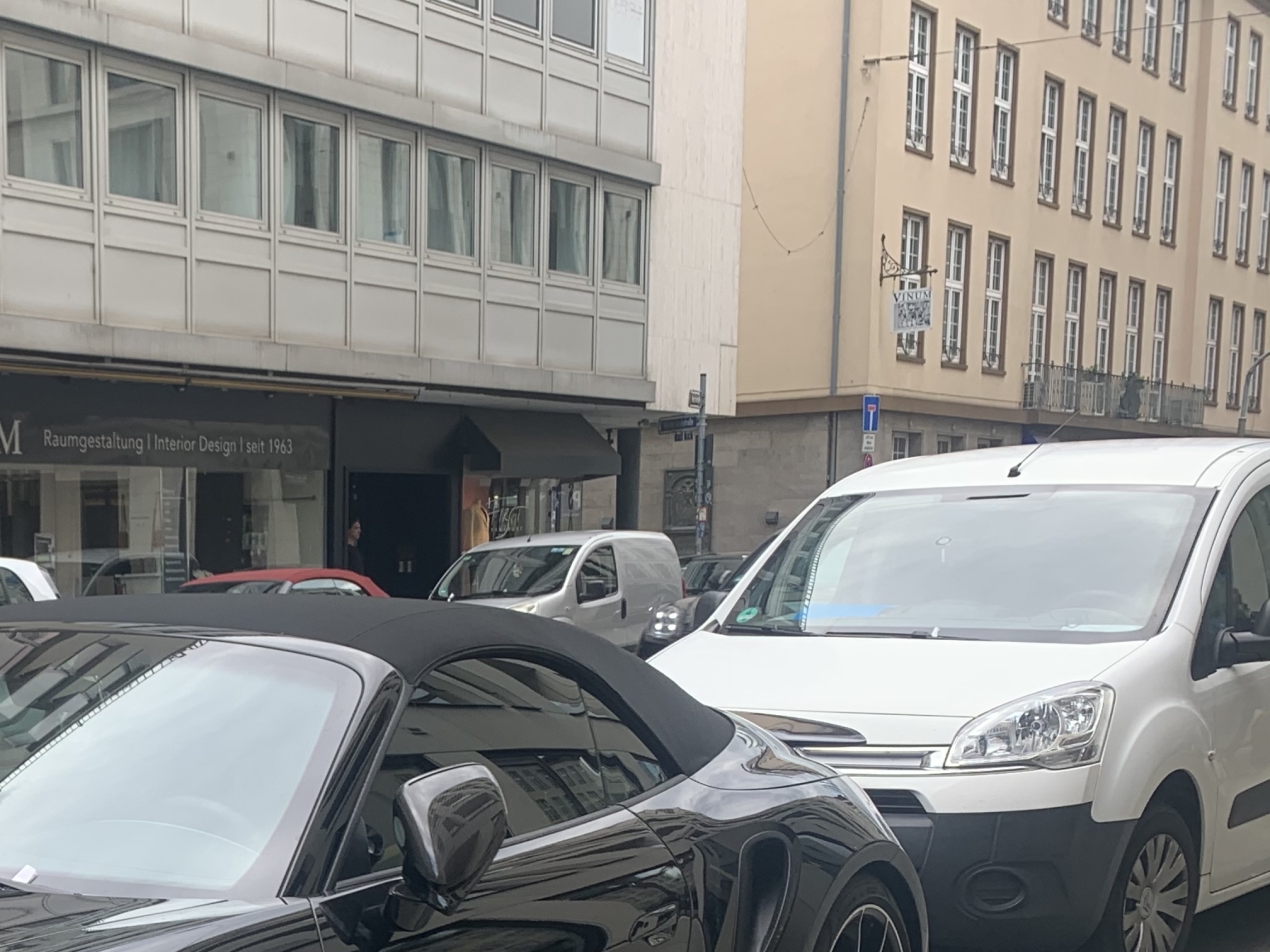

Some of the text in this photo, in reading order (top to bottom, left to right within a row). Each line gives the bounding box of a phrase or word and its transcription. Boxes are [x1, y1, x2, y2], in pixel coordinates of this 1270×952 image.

[893, 290, 931, 303] VINUM
[43, 429, 144, 455] Raumgestaltung
[154, 434, 196, 452] Interior
[199, 435, 237, 457] Design
[246, 438, 265, 454] seit
[268, 438, 293, 455] 1963
